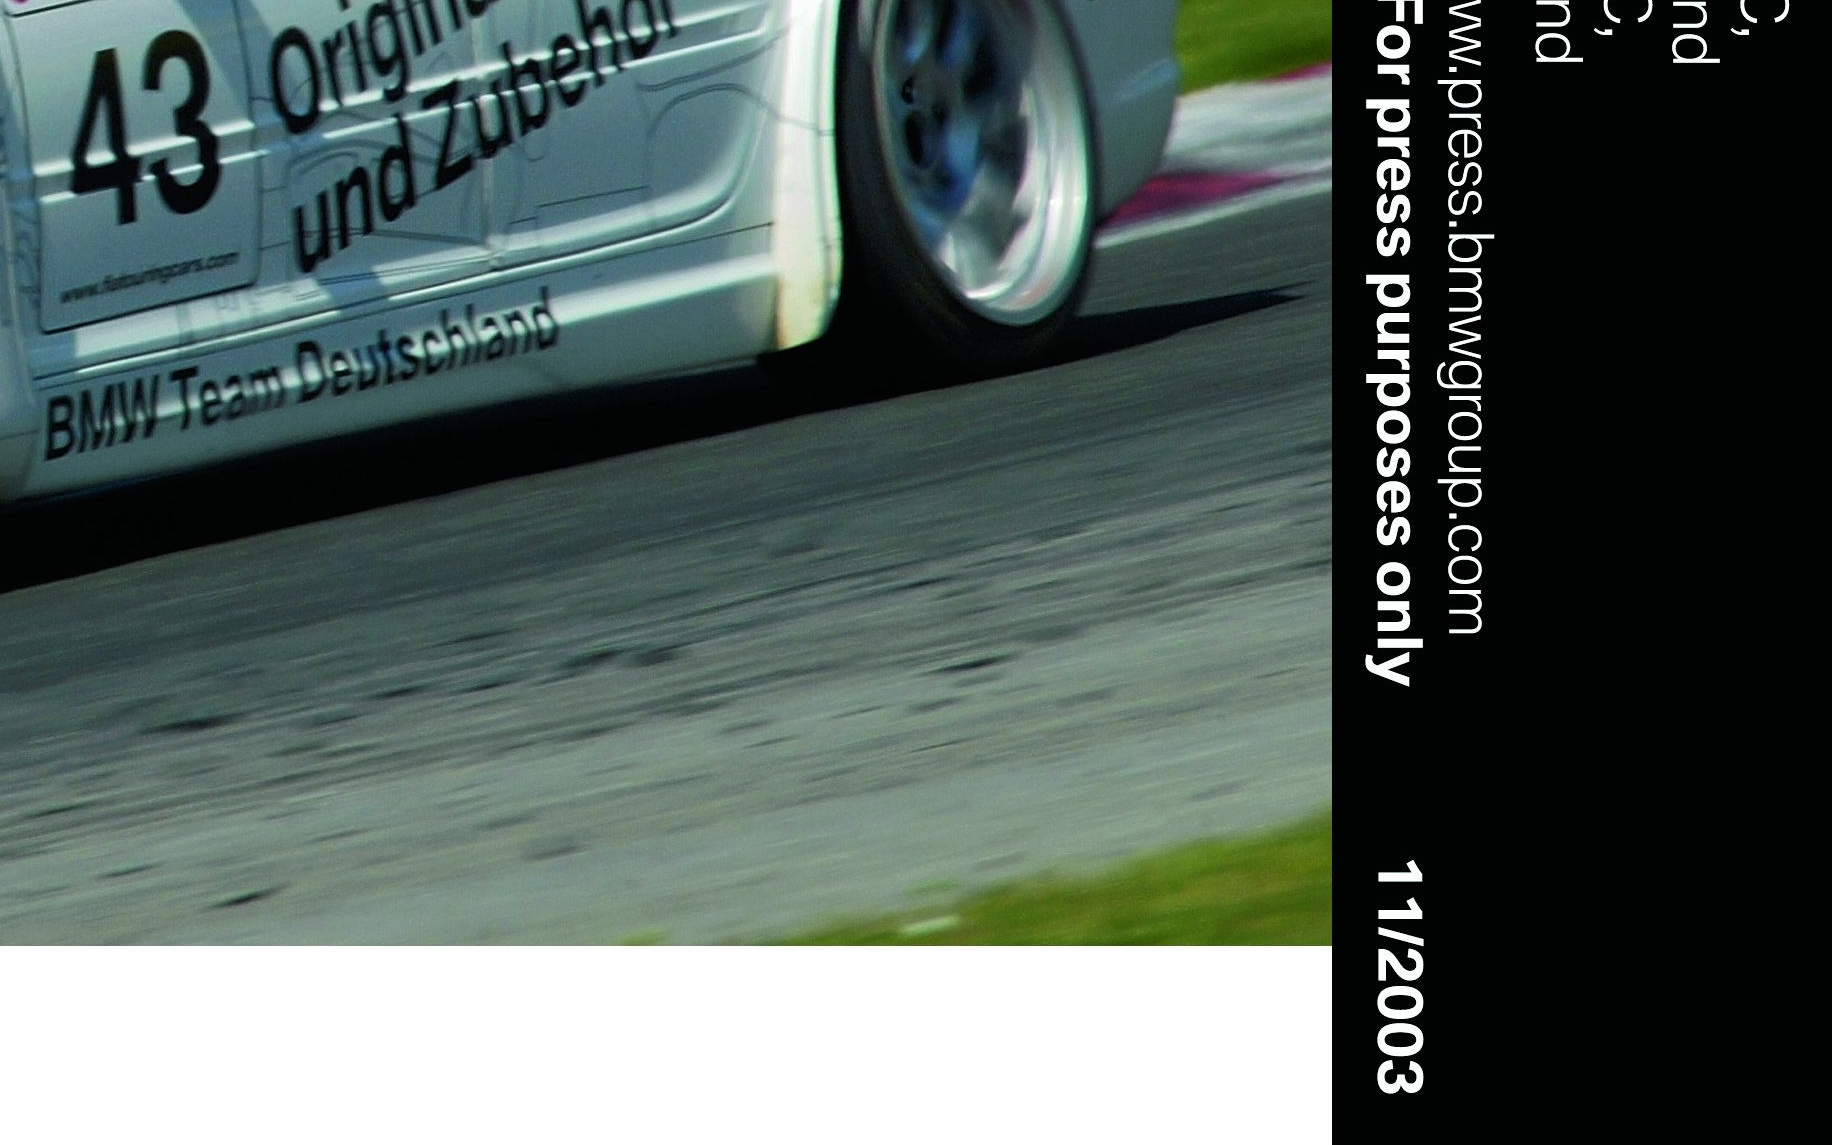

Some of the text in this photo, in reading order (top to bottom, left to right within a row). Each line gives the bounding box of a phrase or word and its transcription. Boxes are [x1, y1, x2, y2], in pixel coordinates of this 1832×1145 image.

[73, 29, 222, 226] 43
[293, 114, 416, 273] und
[44, 286, 561, 462] BMW Team Deutschland
